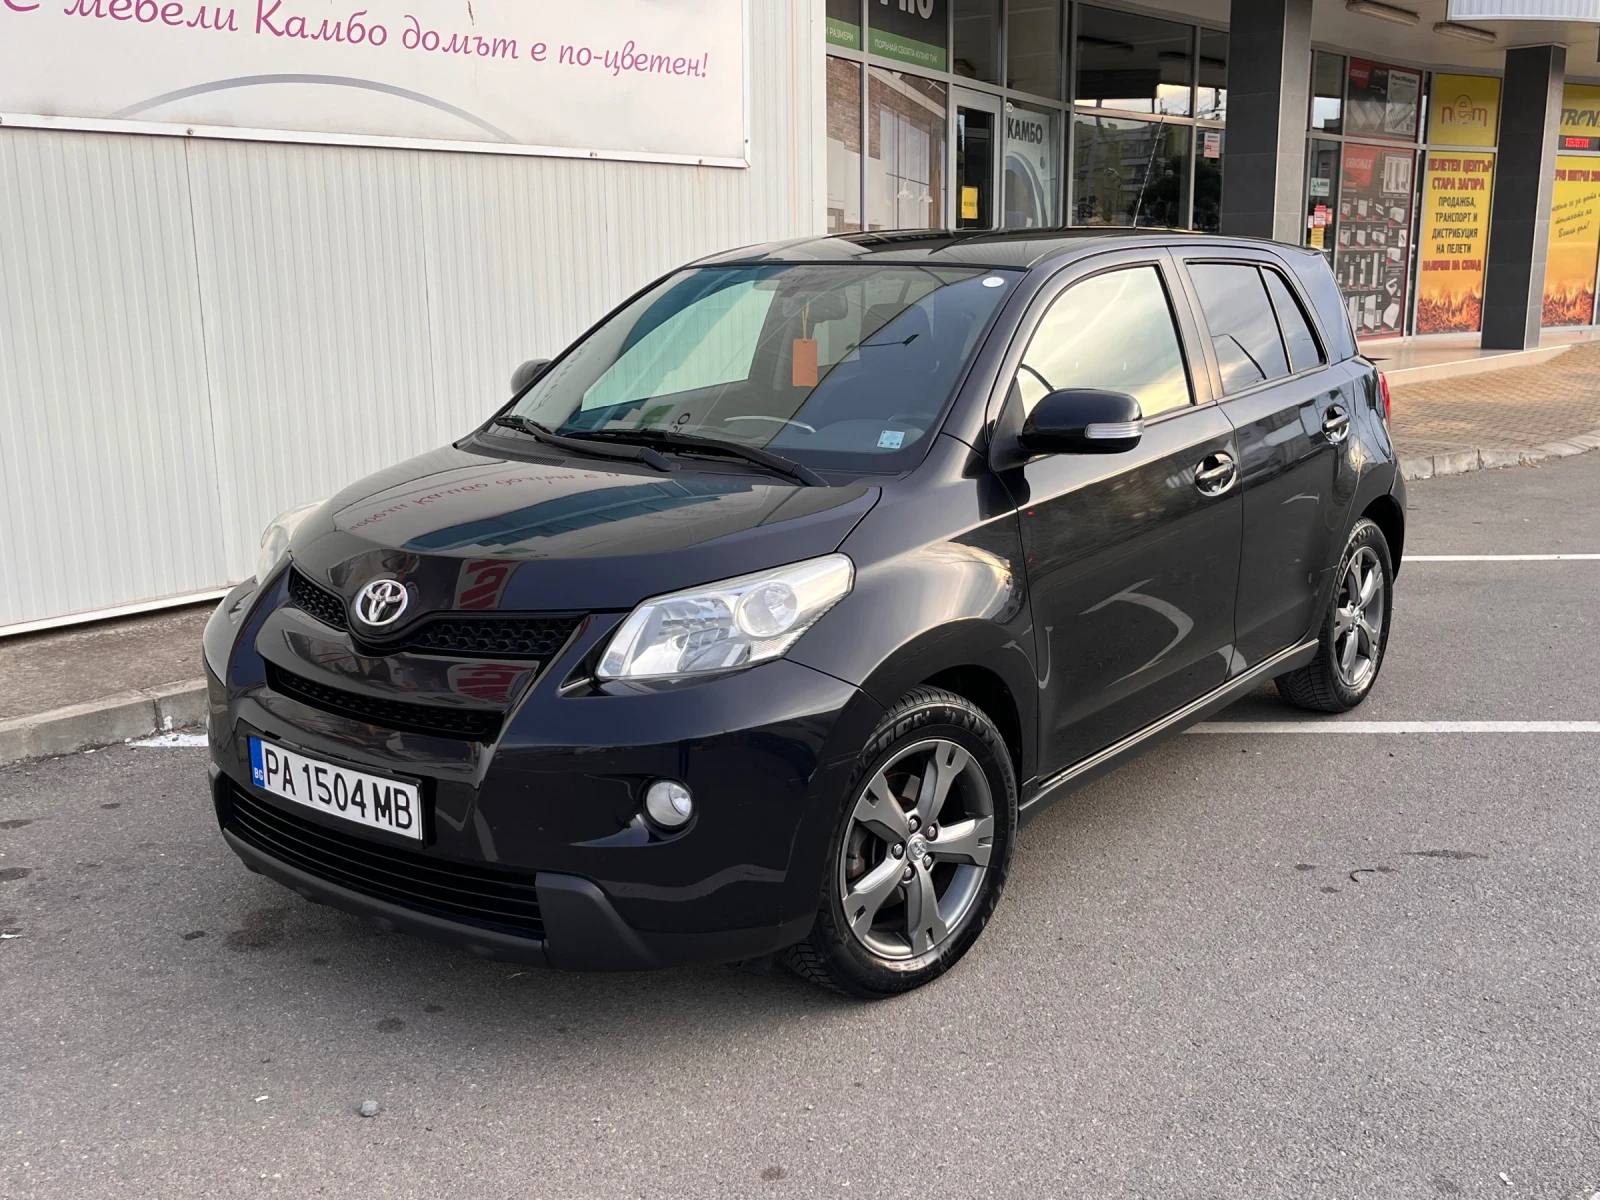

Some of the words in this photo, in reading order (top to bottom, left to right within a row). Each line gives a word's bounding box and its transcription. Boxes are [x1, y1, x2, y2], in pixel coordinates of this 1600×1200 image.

[64, 0, 238, 31] мебели
[256, 0, 387, 46] Камбо
[402, 15, 518, 60] домът
[530, 42, 547, 61] е
[558, 41, 708, 78] по-цветен!
[829, 27, 854, 42] РАЗМЕРИ
[874, 38, 898, 53] ПОРЪЧАЙ
[1007, 117, 1043, 144] КАМБО
[1428, 158, 1461, 172] ПЕЛЕТЕН
[1462, 159, 1493, 174] ЦЕНТЪР
[1432, 177, 1456, 190] СТАРА
[1457, 178, 1485, 191] ЗАГОРА
[1438, 196, 1476, 208] ПРОДАЖБА,
[1435, 212, 1472, 222] ТРАНСПОРТ
[1472, 213, 1478, 222] И
[1431, 228, 1478, 240] ДИСТРИБУЦИЯ
[1436, 244, 1445, 254] НА
[1446, 243, 1472, 254] ПЕЛЕТИ
[254, 767, 264, 781] BG
